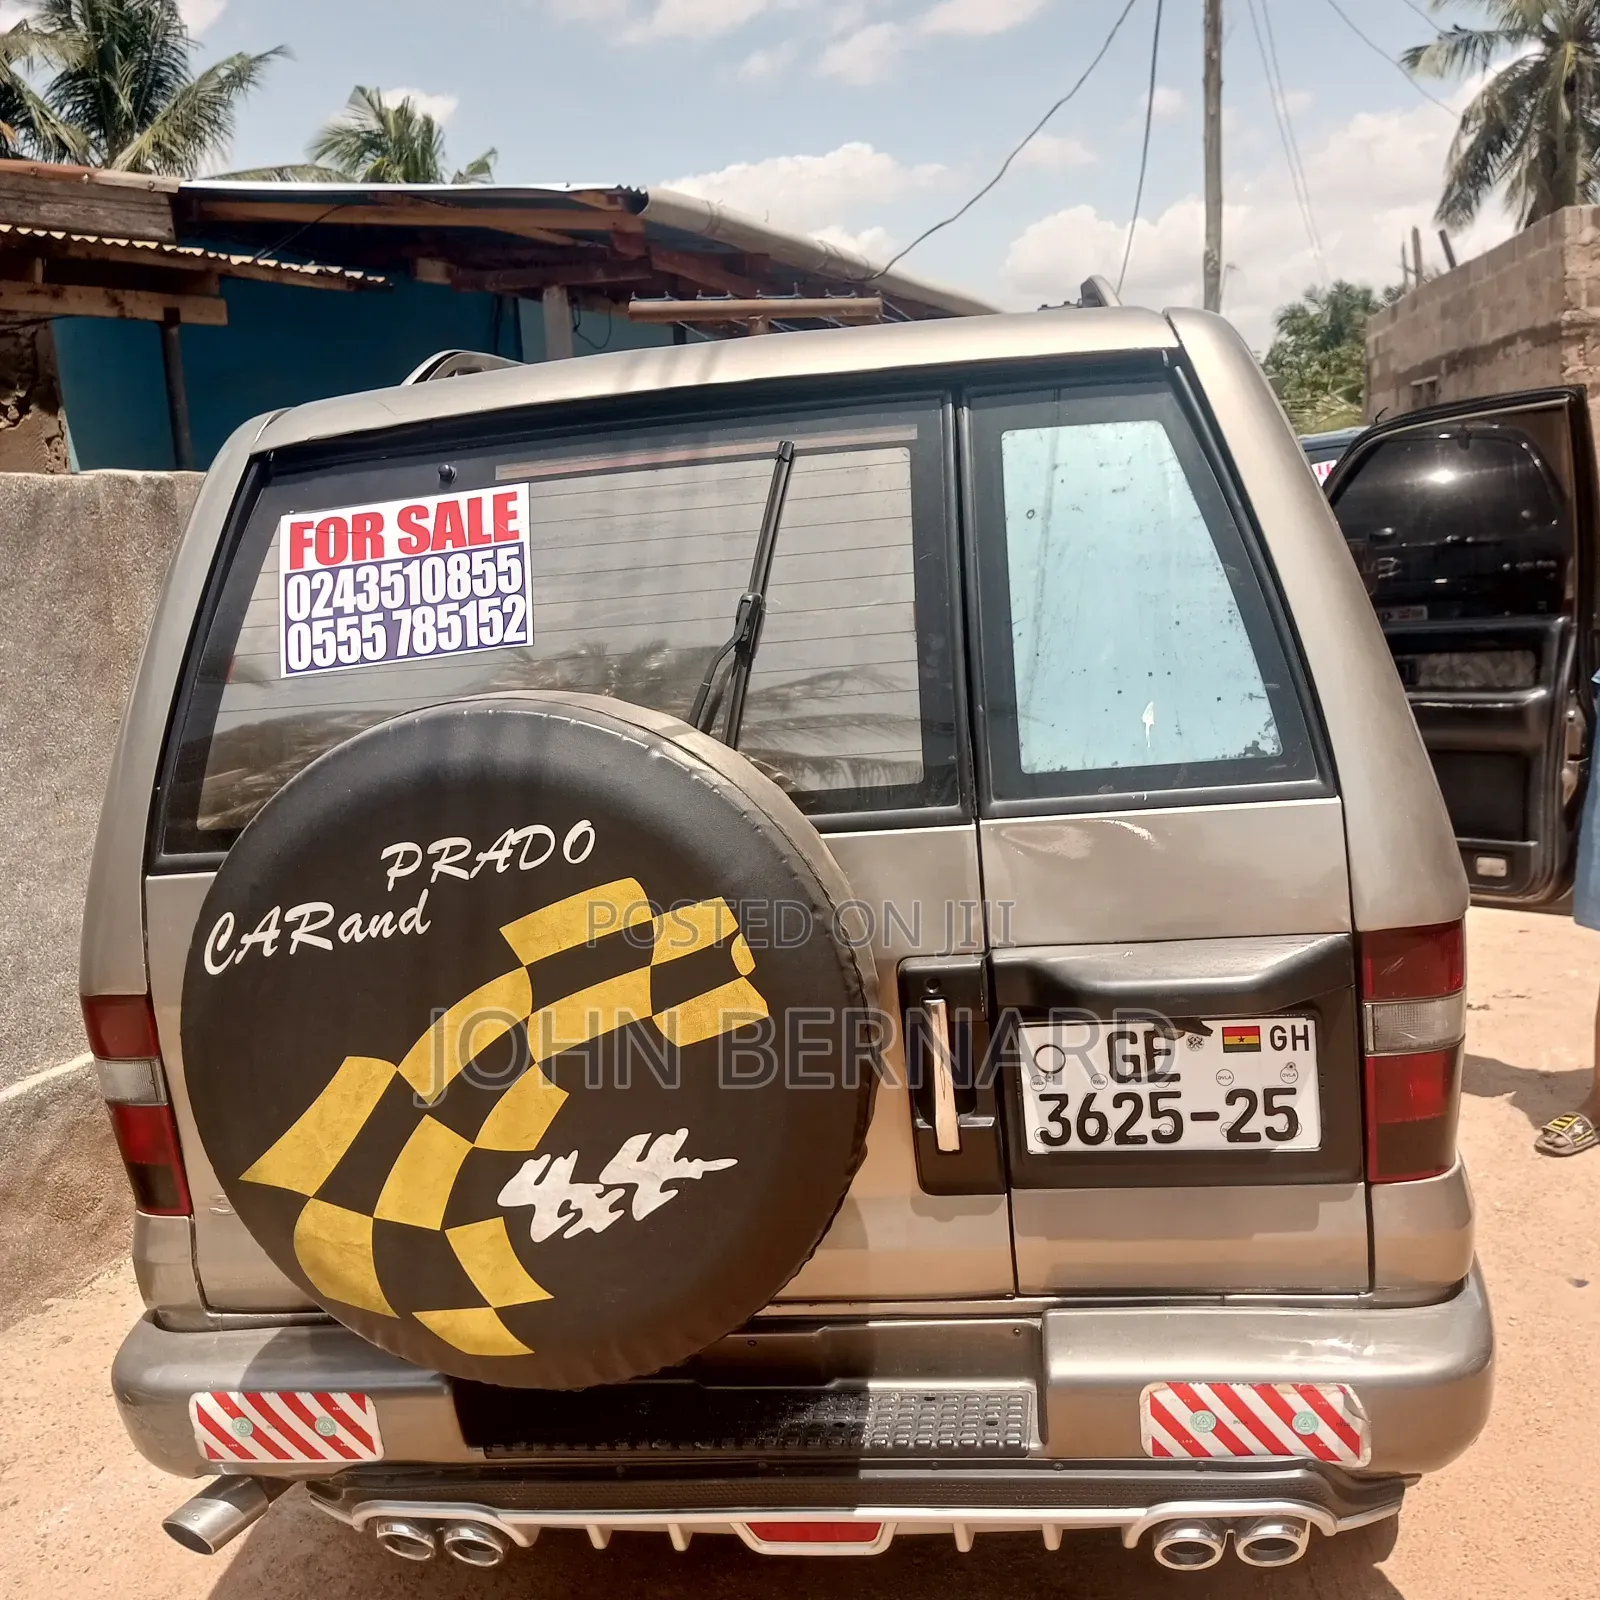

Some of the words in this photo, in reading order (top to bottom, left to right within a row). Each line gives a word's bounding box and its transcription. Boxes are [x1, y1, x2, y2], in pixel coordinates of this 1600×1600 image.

[289, 511, 385, 570] FOR
[396, 491, 520, 555] SALE
[286, 546, 523, 622] 0243510855
[286, 612, 387, 671] 0555
[392, 593, 527, 657] 785152
[380, 819, 596, 892] PRADO
[203, 888, 432, 977] CARand
[1106, 1029, 1181, 1084] GE
[1269, 1024, 1310, 1052] GH
[1038, 1087, 1300, 1146] 3625-25
